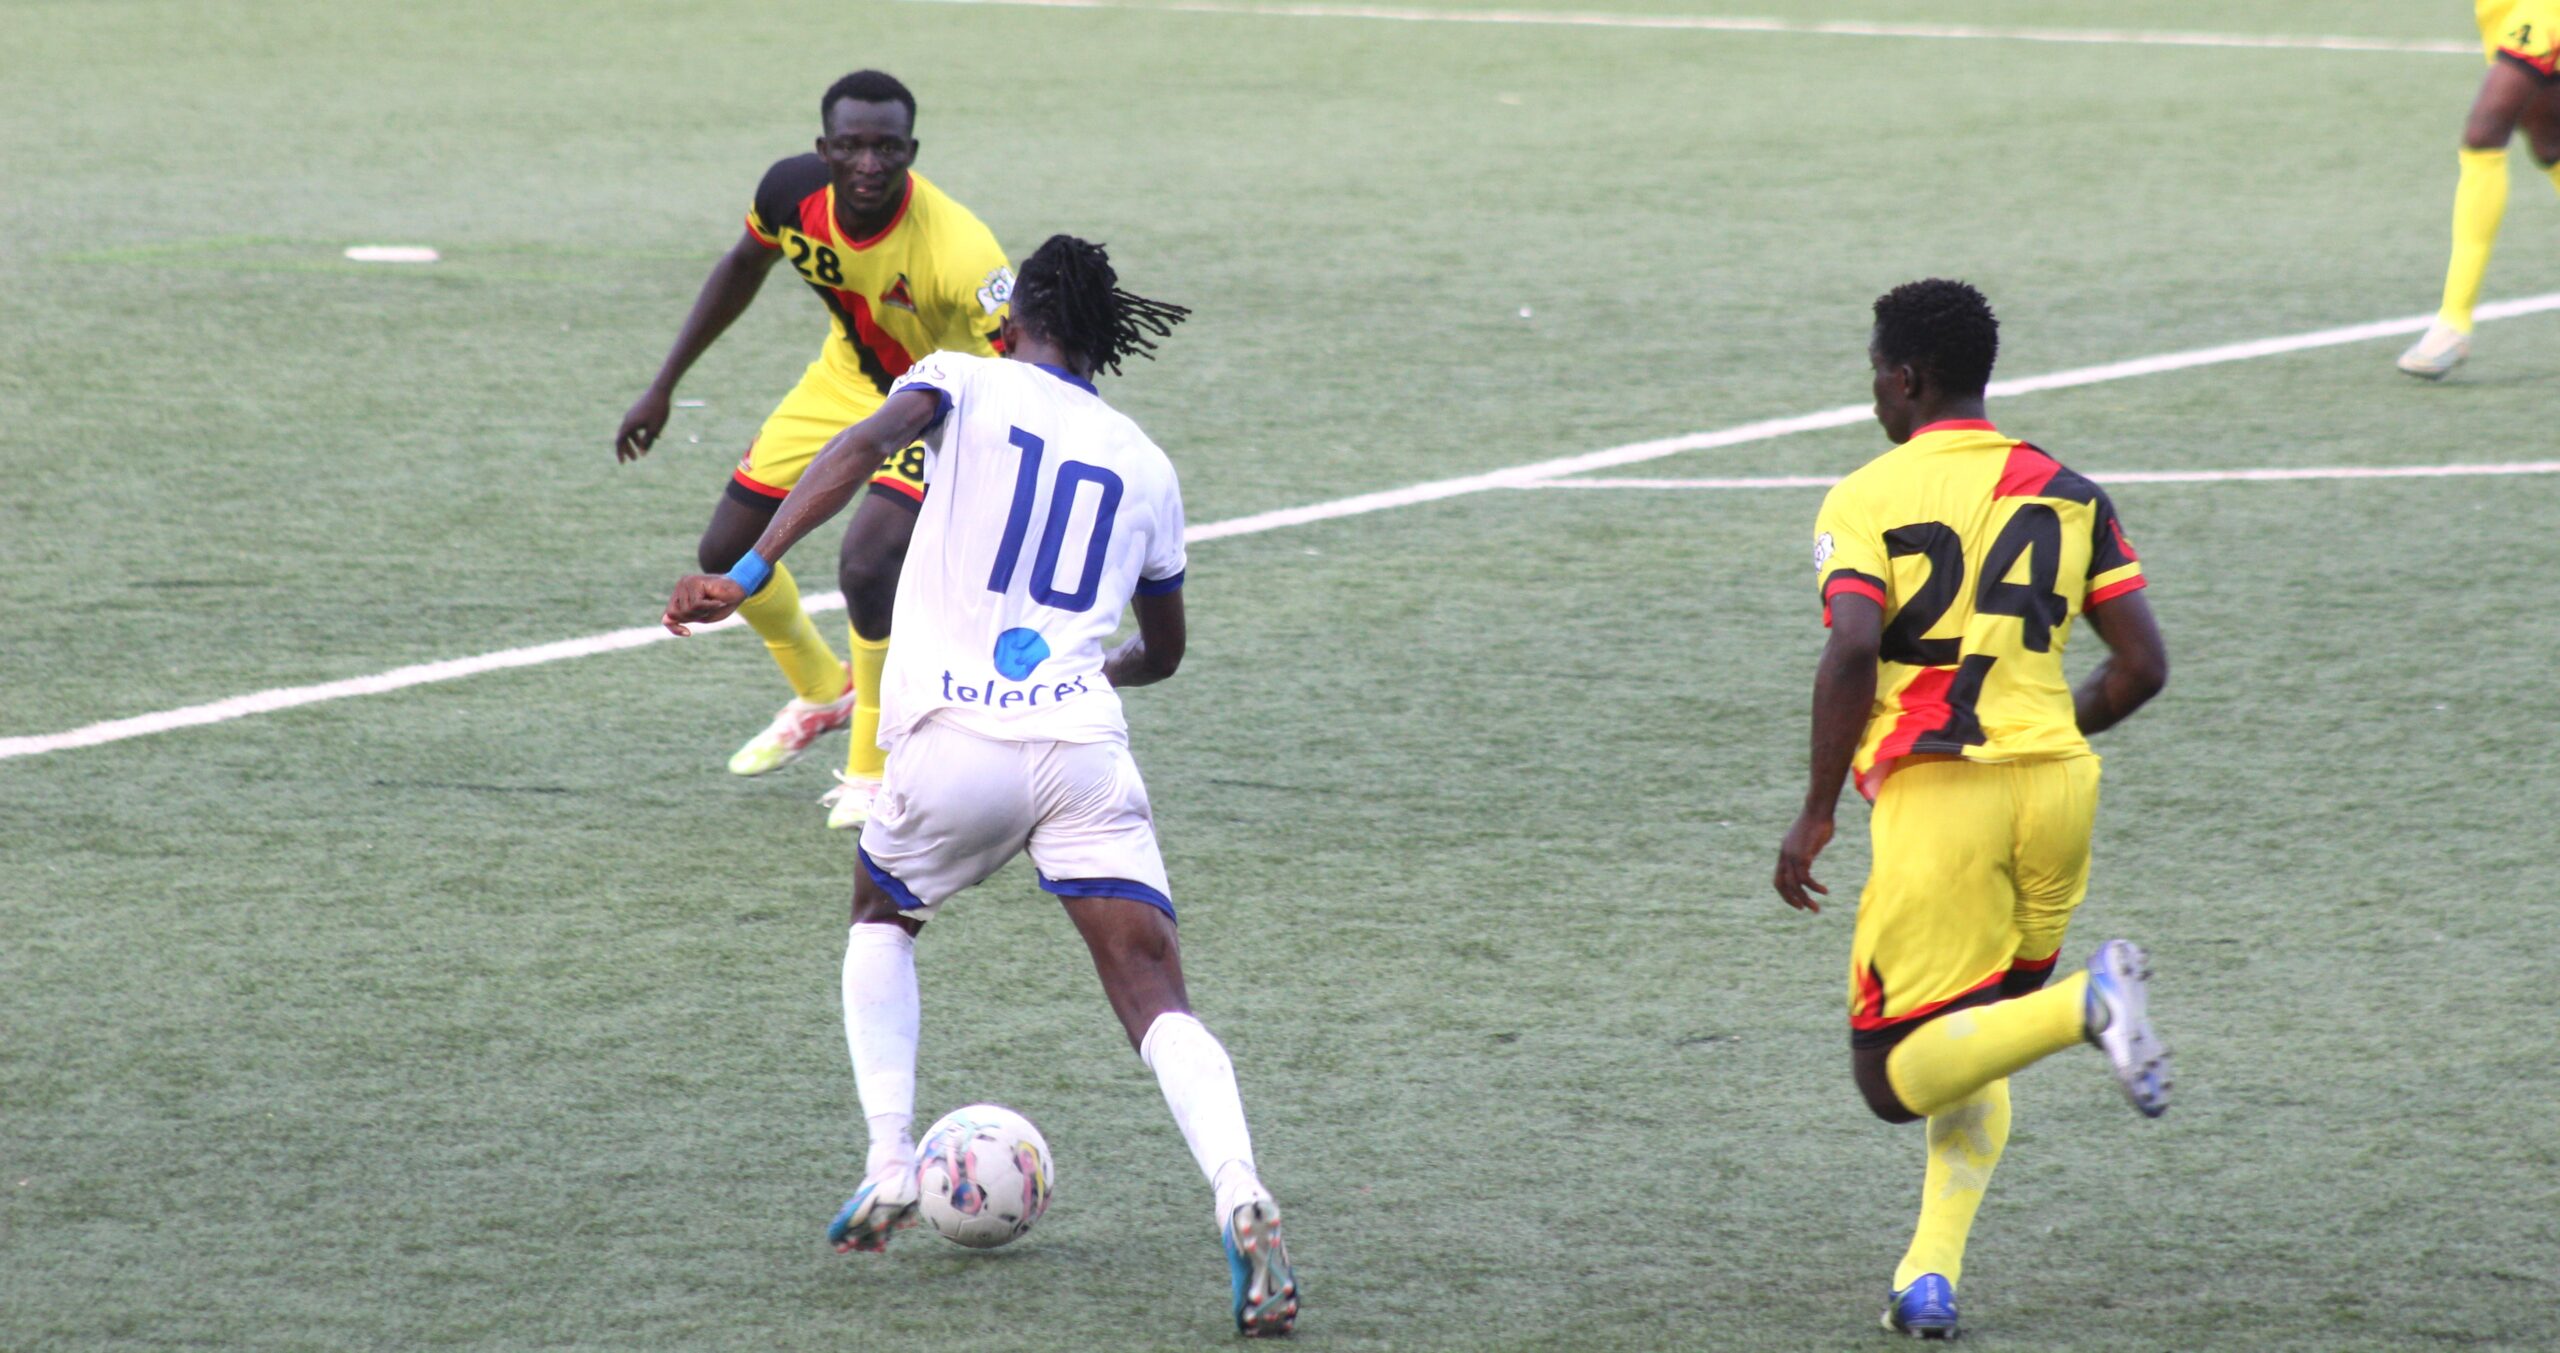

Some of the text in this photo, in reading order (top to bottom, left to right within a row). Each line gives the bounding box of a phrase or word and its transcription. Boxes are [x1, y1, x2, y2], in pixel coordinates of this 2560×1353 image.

[790, 234, 844, 284] 28
[987, 424, 1125, 613] 10
[1878, 502, 2068, 667] 24
